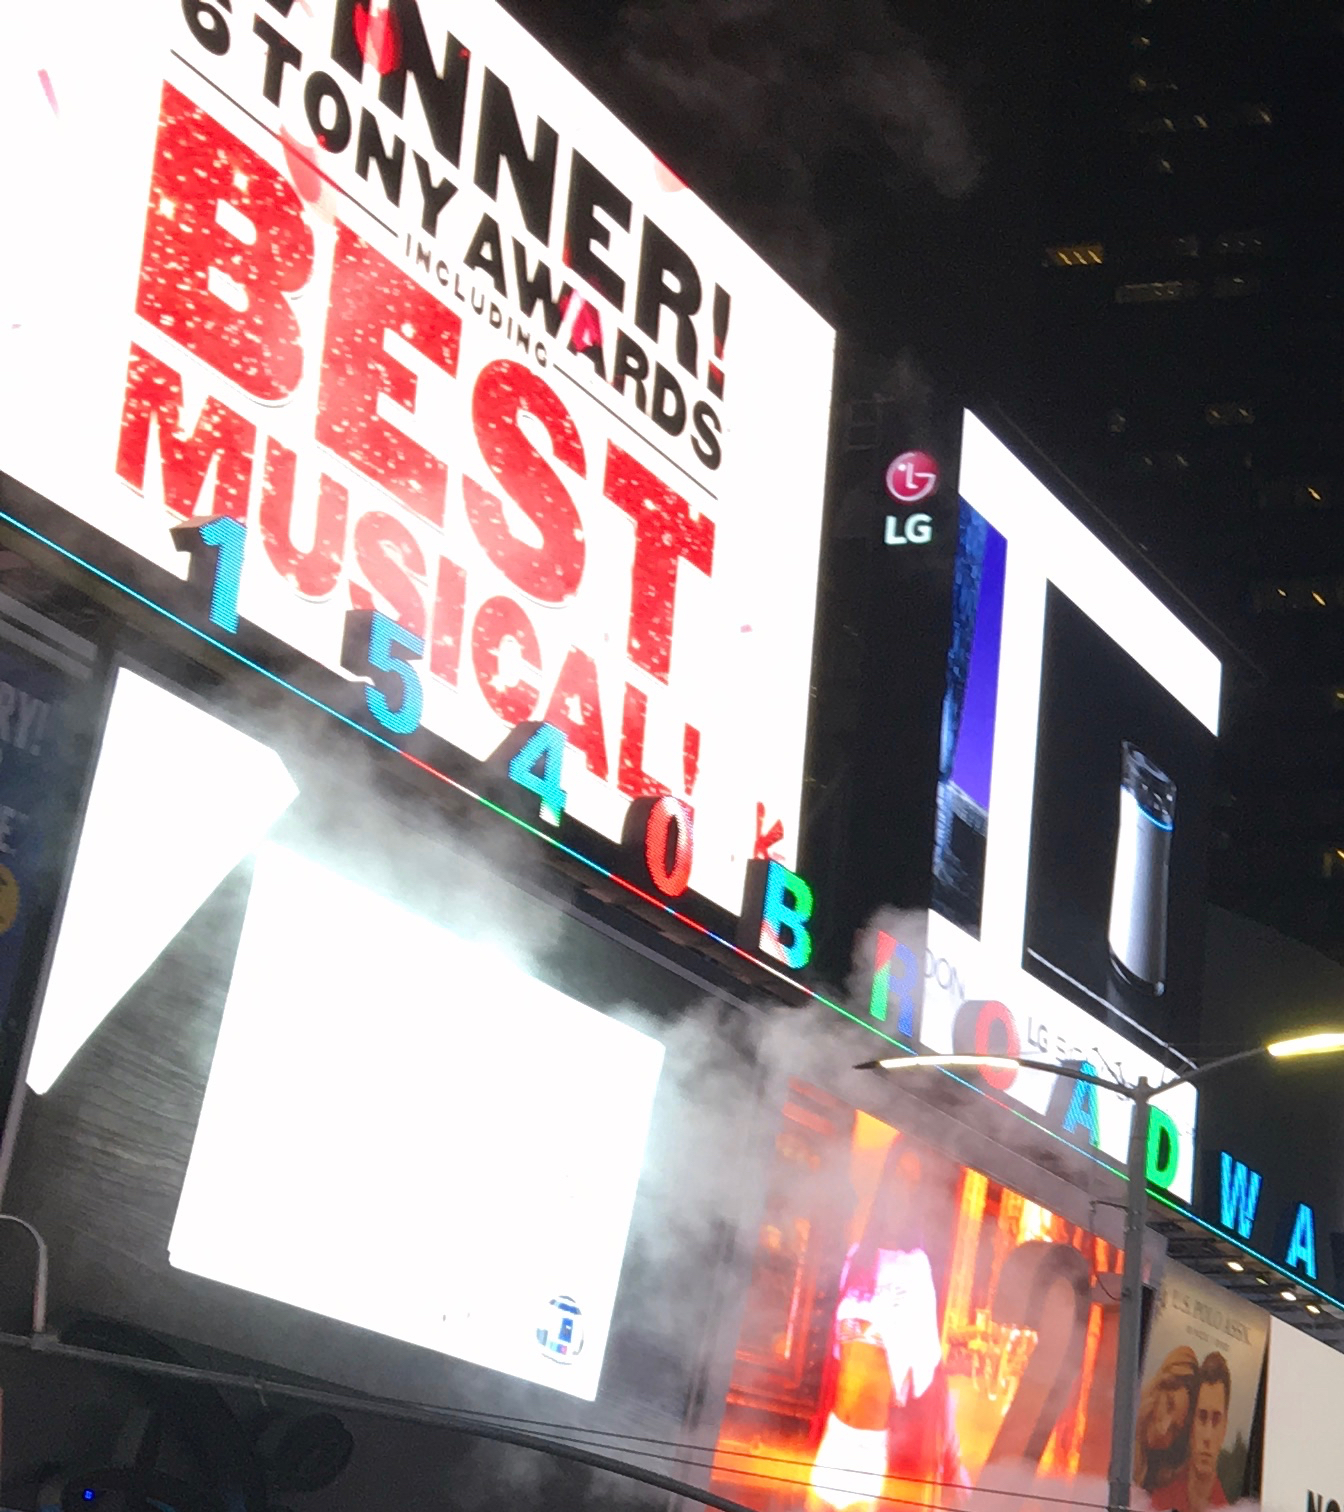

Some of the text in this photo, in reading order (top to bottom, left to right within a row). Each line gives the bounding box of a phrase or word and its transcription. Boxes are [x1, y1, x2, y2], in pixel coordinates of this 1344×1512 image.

[135, 78, 717, 686] BEST
[252, 12, 458, 238] TONY
[464, 214, 722, 471] AWARDS
[264, 0, 732, 400] INNER!
[406, 232, 549, 368] INCLUDING
[115, 340, 700, 802] MUSICAL!
[882, 512, 933, 546] LG
